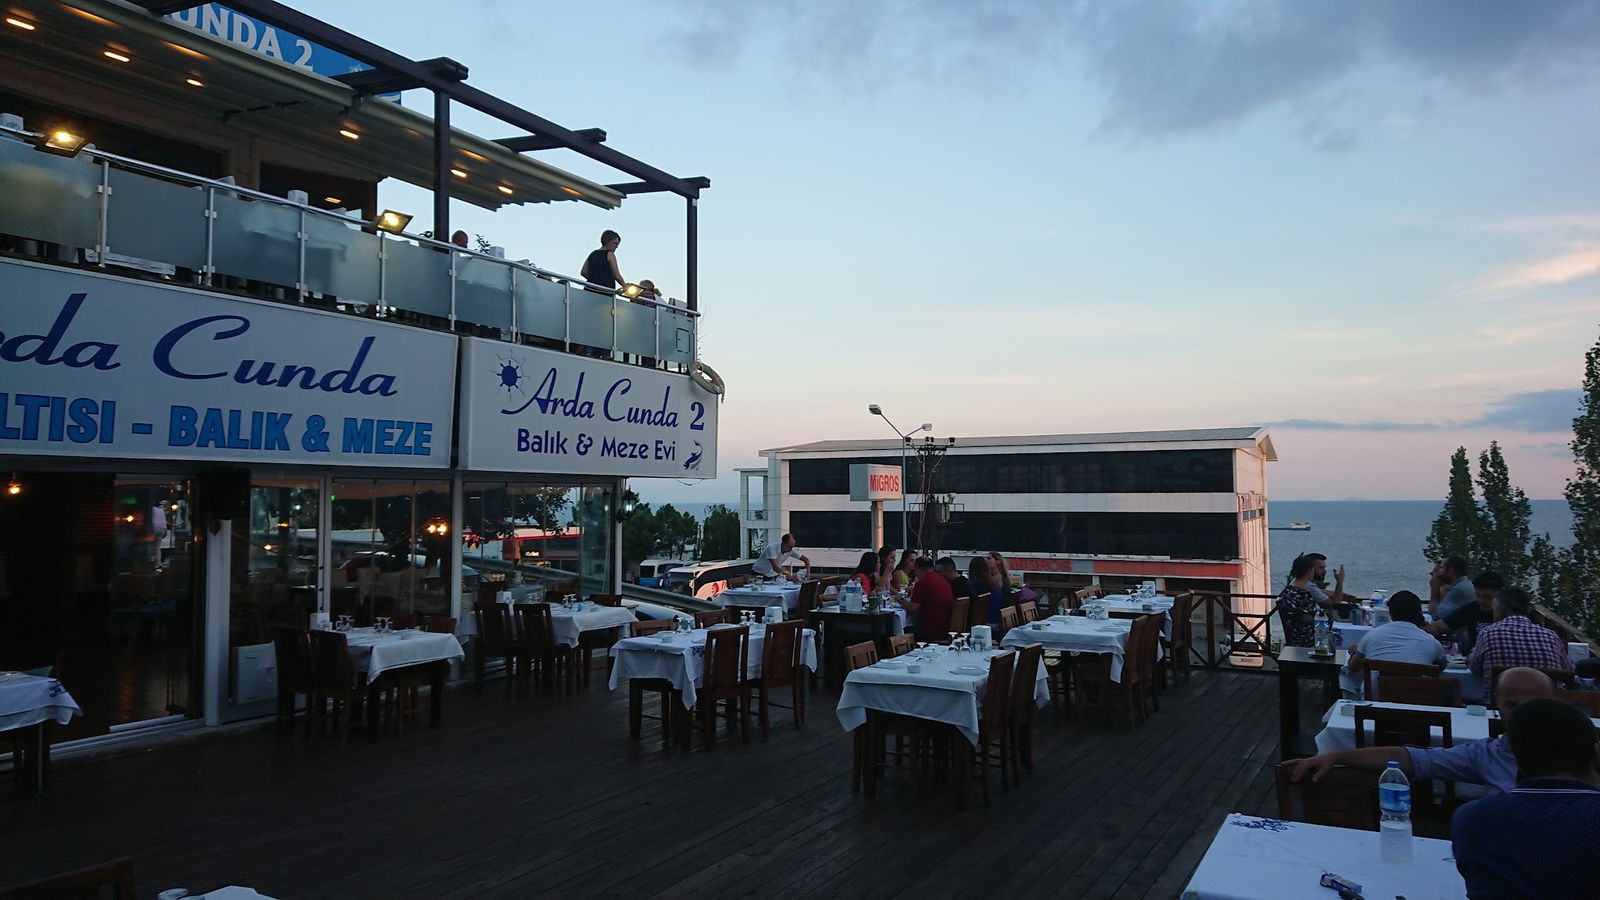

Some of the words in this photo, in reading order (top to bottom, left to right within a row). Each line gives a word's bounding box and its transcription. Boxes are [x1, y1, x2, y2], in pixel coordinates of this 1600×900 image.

[164, 3, 284, 62] UNDA
[295, 40, 313, 72] 2
[0, 293, 121, 370] da
[153, 315, 398, 397] Cunda
[168, 405, 292, 451] BALIK
[301, 414, 330, 453] &
[342, 417, 433, 456] MEZE
[501, 368, 595, 419] Arda
[603, 378, 679, 428] Cunda
[689, 401, 706, 431] 2
[517, 428, 568, 455] Balık
[576, 433, 594, 456] &
[600, 436, 649, 460] Meze
[654, 440, 676, 461] Evi
